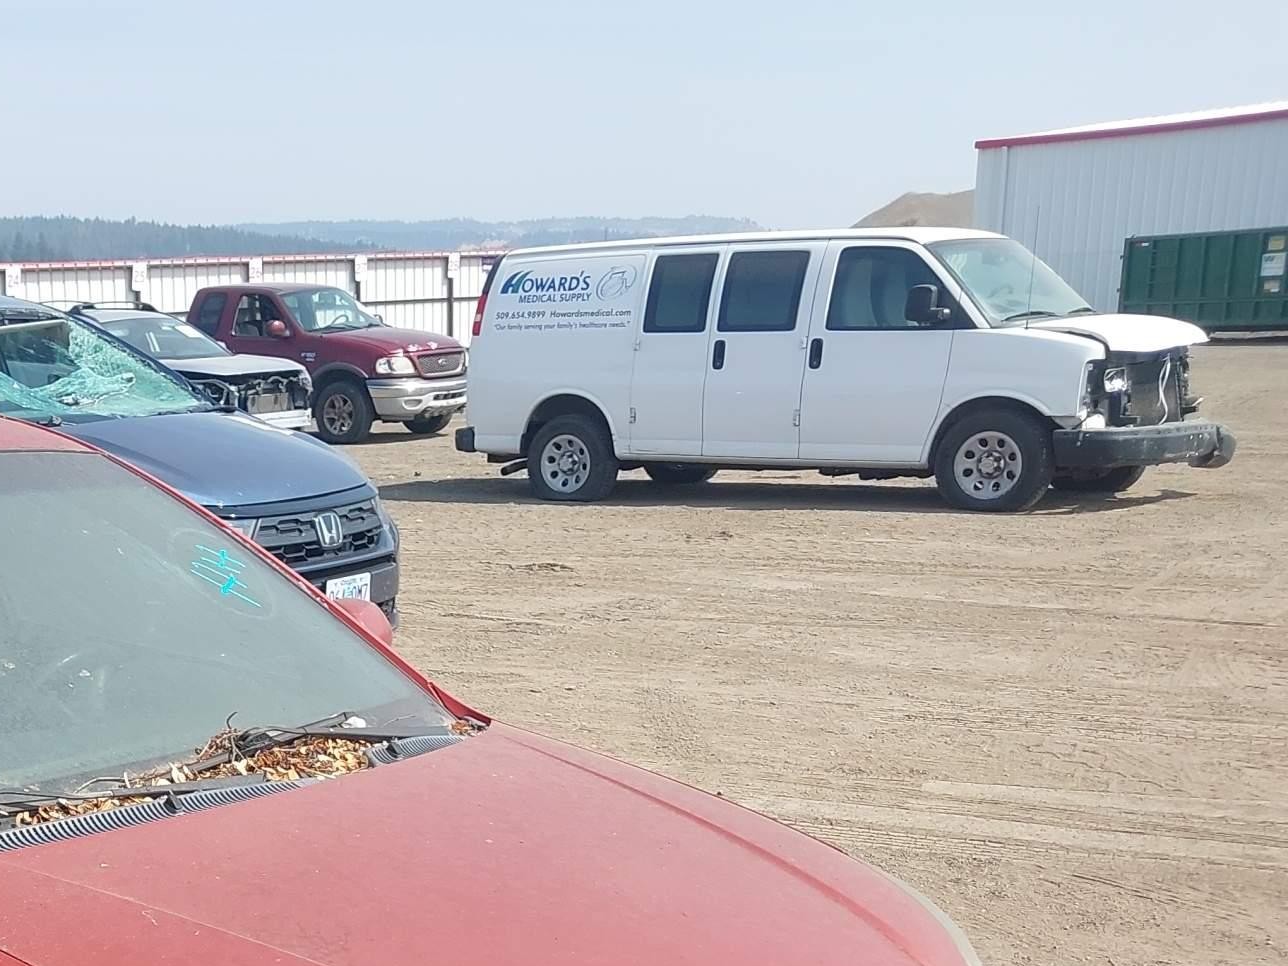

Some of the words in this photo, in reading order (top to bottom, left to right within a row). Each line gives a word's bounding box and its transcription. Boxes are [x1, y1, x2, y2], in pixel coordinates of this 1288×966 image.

[8, 274, 19, 288] 24
[500, 270, 591, 294] HOWARD'S
[519, 294, 556, 304] MEDICAL
[559, 292, 592, 302] SUPPLY
[550, 309, 631, 318] Howardsmedical.com
